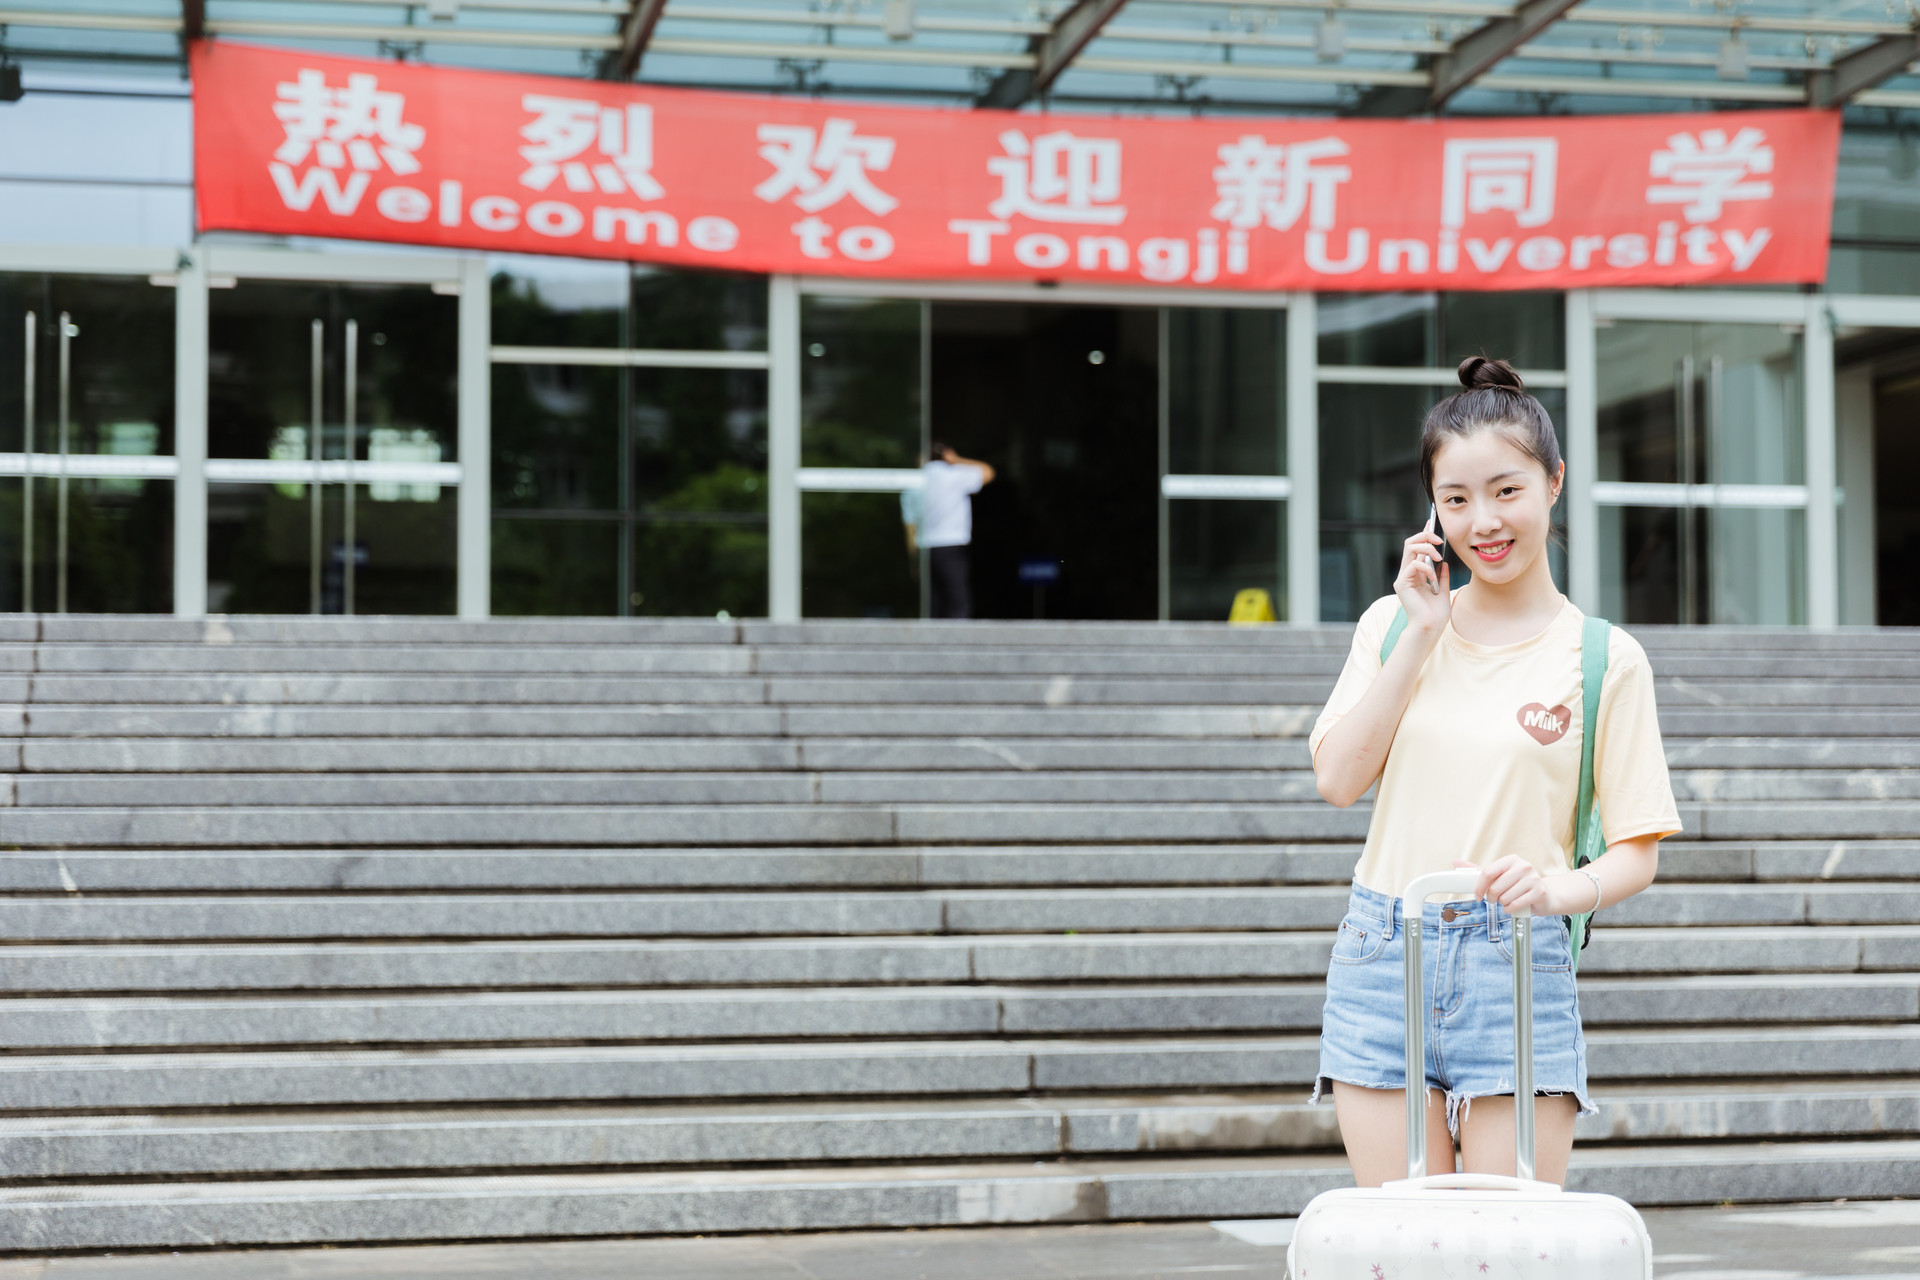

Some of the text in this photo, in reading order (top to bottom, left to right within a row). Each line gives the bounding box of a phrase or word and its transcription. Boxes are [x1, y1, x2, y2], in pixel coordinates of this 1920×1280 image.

[272, 70, 1775, 231] 热烈欢迎新同学
[269, 163, 1772, 283] Welcome to Tongji University
[1524, 710, 1563, 734] Milk
